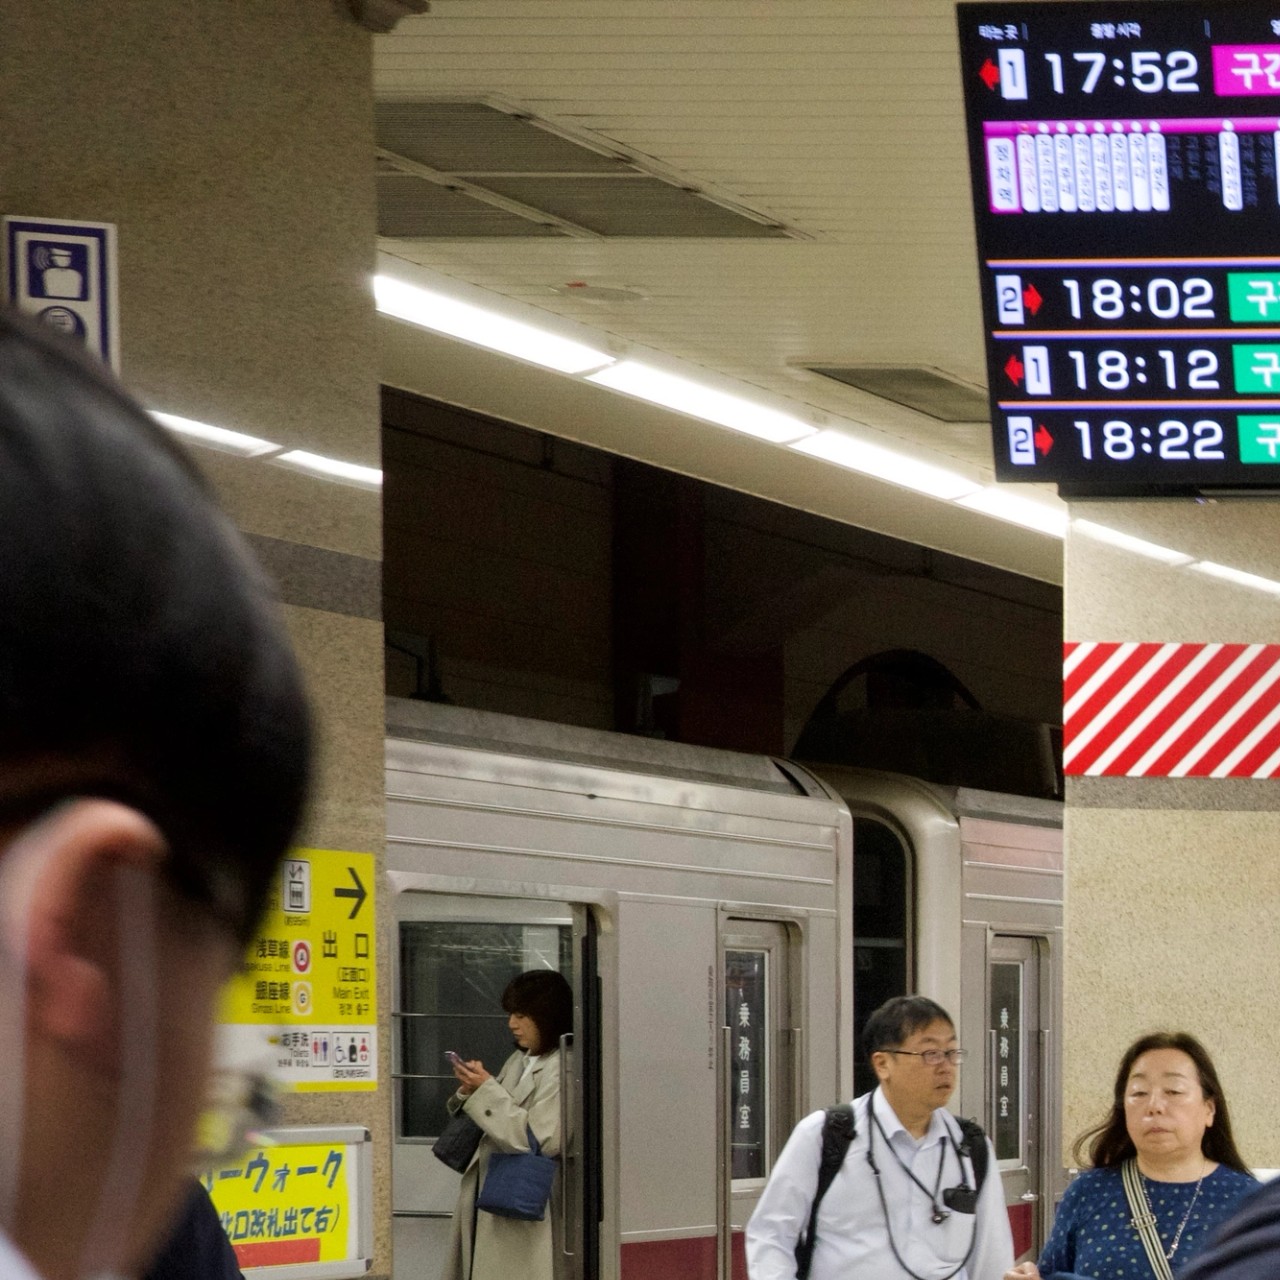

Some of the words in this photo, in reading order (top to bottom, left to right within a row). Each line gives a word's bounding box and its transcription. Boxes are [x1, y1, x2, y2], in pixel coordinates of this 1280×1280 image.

[1007, 60, 1017, 88] 1
[1044, 50, 1200, 93] 17:52
[1003, 288, 1018, 311] 2
[1064, 278, 1215, 320] 18:02
[1031, 357, 1042, 385] 1
[1069, 349, 1220, 390] 18:12
[1014, 429, 1029, 453] 2
[1074, 419, 1225, 460] 18:22
[323, 930, 369, 959] 出口
[255, 980, 290, 1000] 銀座線
[333, 986, 351, 999] Main
[354, 986, 370, 999] Exit
[738, 1002, 751, 1129] 乗務員室
[999, 1007, 1010, 1117] 乗務員室
